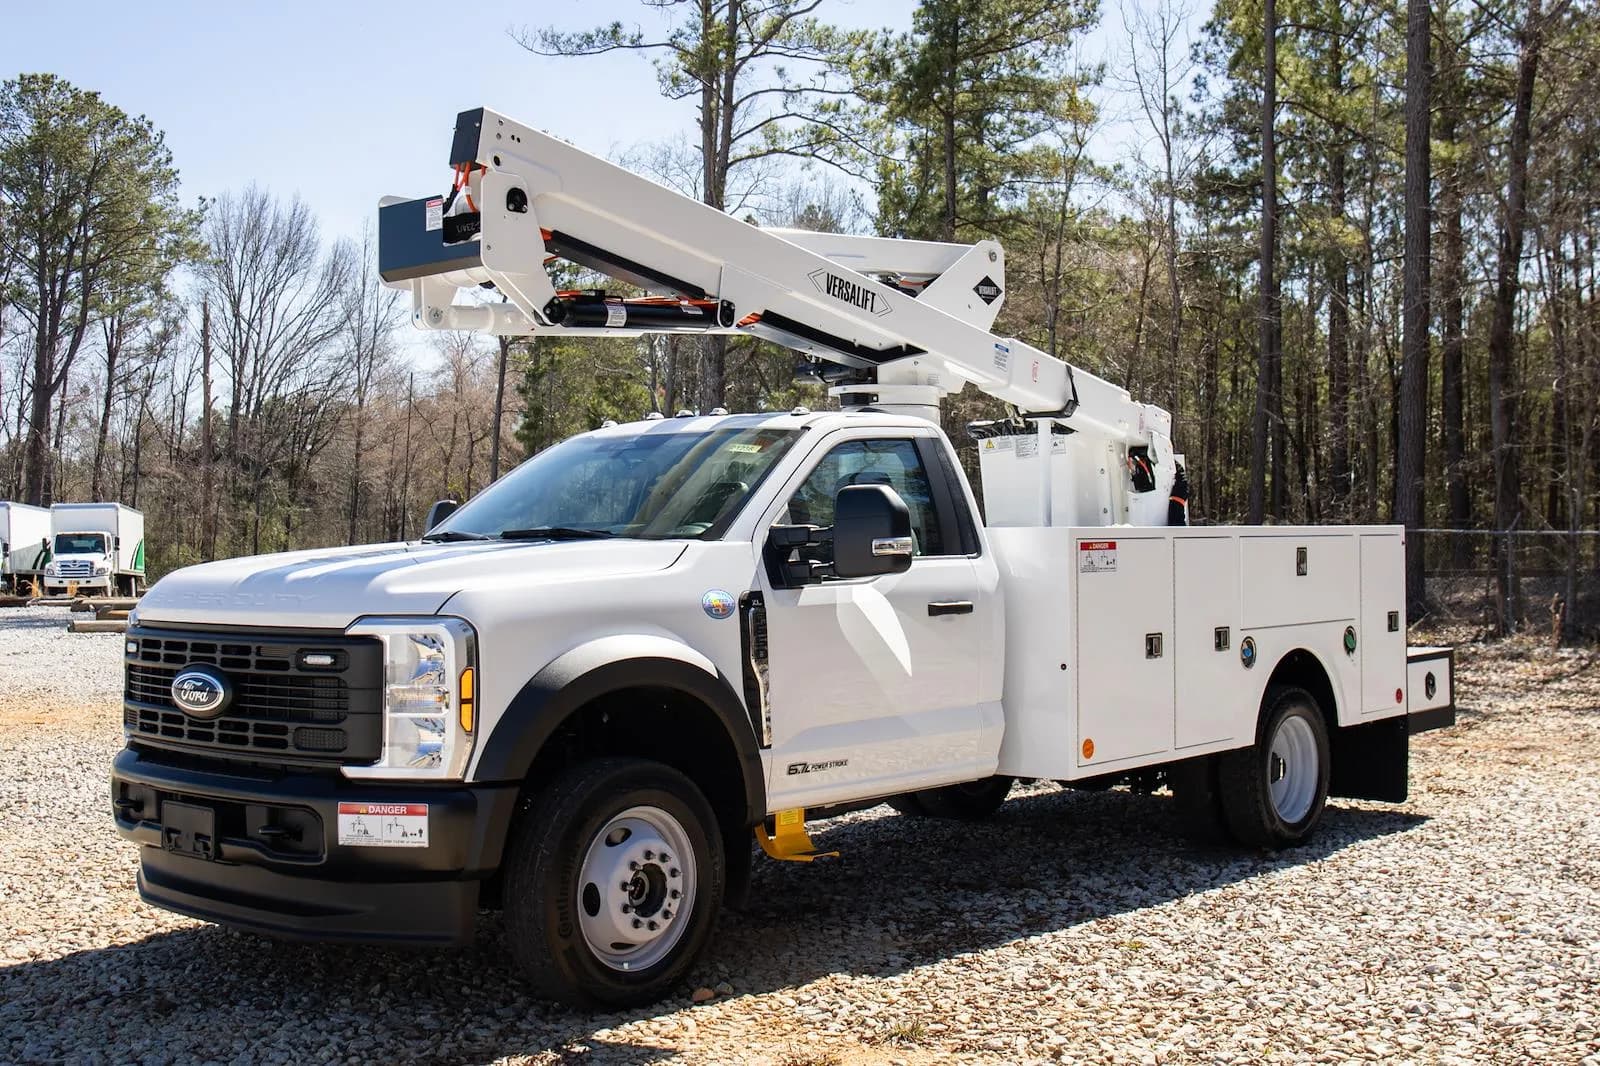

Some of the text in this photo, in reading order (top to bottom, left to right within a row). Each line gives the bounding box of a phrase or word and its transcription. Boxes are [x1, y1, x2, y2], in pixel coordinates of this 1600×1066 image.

[826, 273, 877, 313] VERSALIFT
[181, 679, 210, 703] Ford
[787, 762, 811, 775] 6.7L
[368, 805, 408, 815] DANGER
